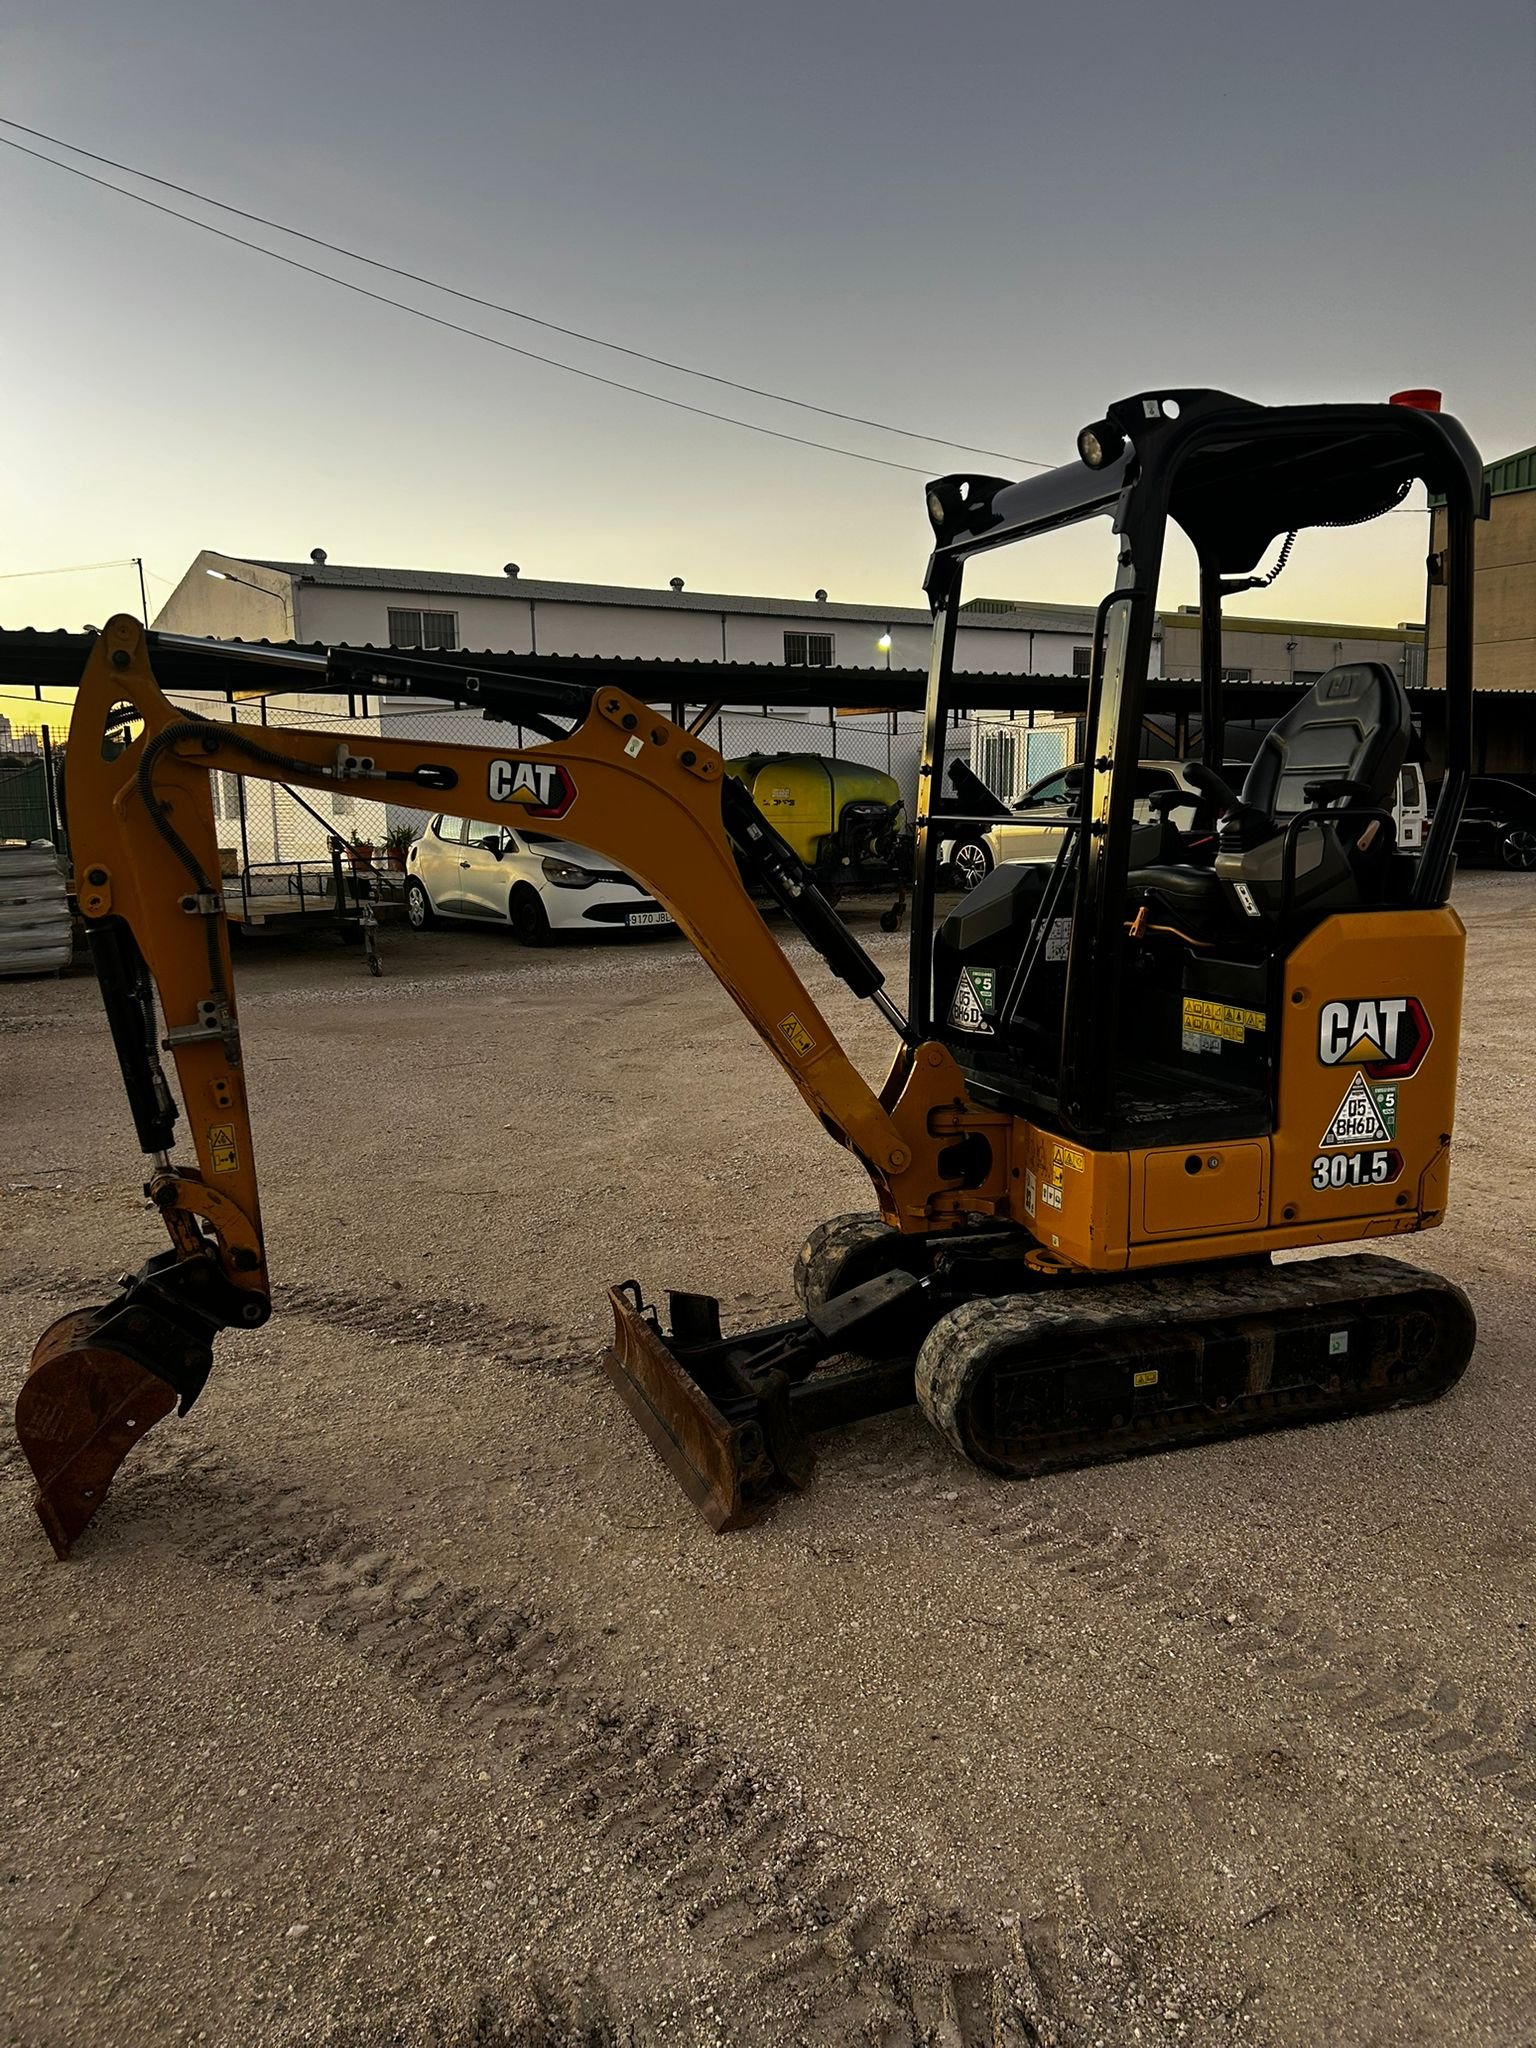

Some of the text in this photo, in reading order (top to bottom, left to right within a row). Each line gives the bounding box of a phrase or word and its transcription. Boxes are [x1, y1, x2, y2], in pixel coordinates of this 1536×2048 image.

[489, 760, 557, 805] CAT
[631, 914, 654, 924] 9170
[982, 978, 992, 990] 5
[1320, 1000, 1407, 1064] CAT
[1348, 1099, 1367, 1117] 05
[1385, 1093, 1395, 1107] 5
[1337, 1117, 1375, 1136] BH6D
[1313, 1151, 1388, 1189] 301.5
